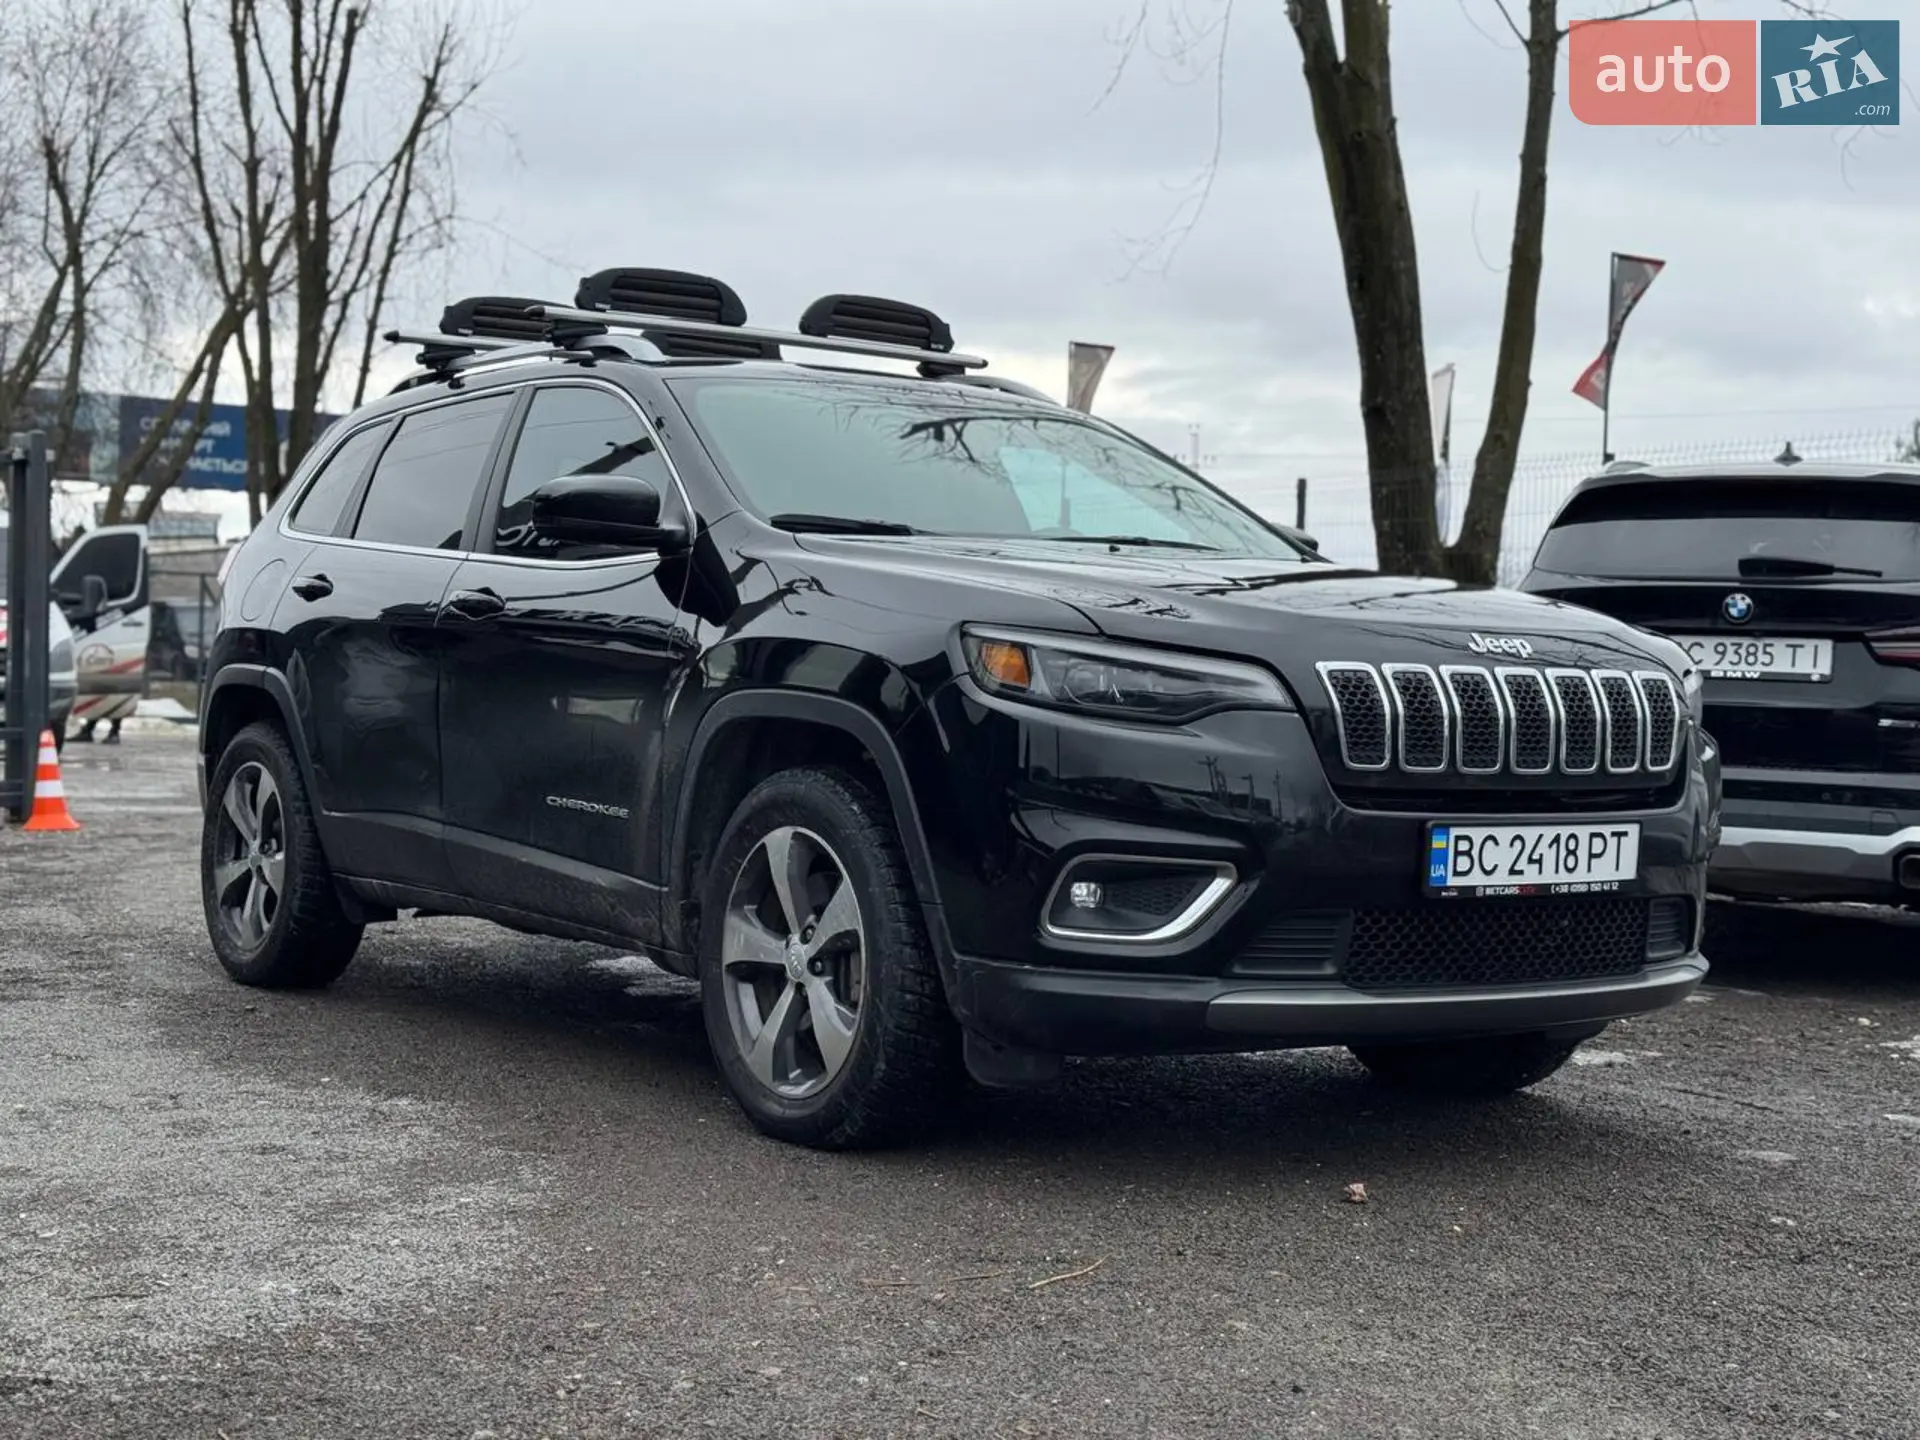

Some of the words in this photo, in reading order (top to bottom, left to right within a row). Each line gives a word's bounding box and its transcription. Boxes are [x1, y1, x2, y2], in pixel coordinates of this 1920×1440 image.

[1468, 632, 1533, 659] Jeep
[1680, 642, 1705, 665] C
[1713, 642, 1775, 667] 9385
[546, 796, 629, 819] CHEROKEE
[1452, 834, 1500, 877] BC
[1508, 832, 1580, 876] 2418
[1587, 831, 1629, 874] PT
[1431, 865, 1446, 878] UA
